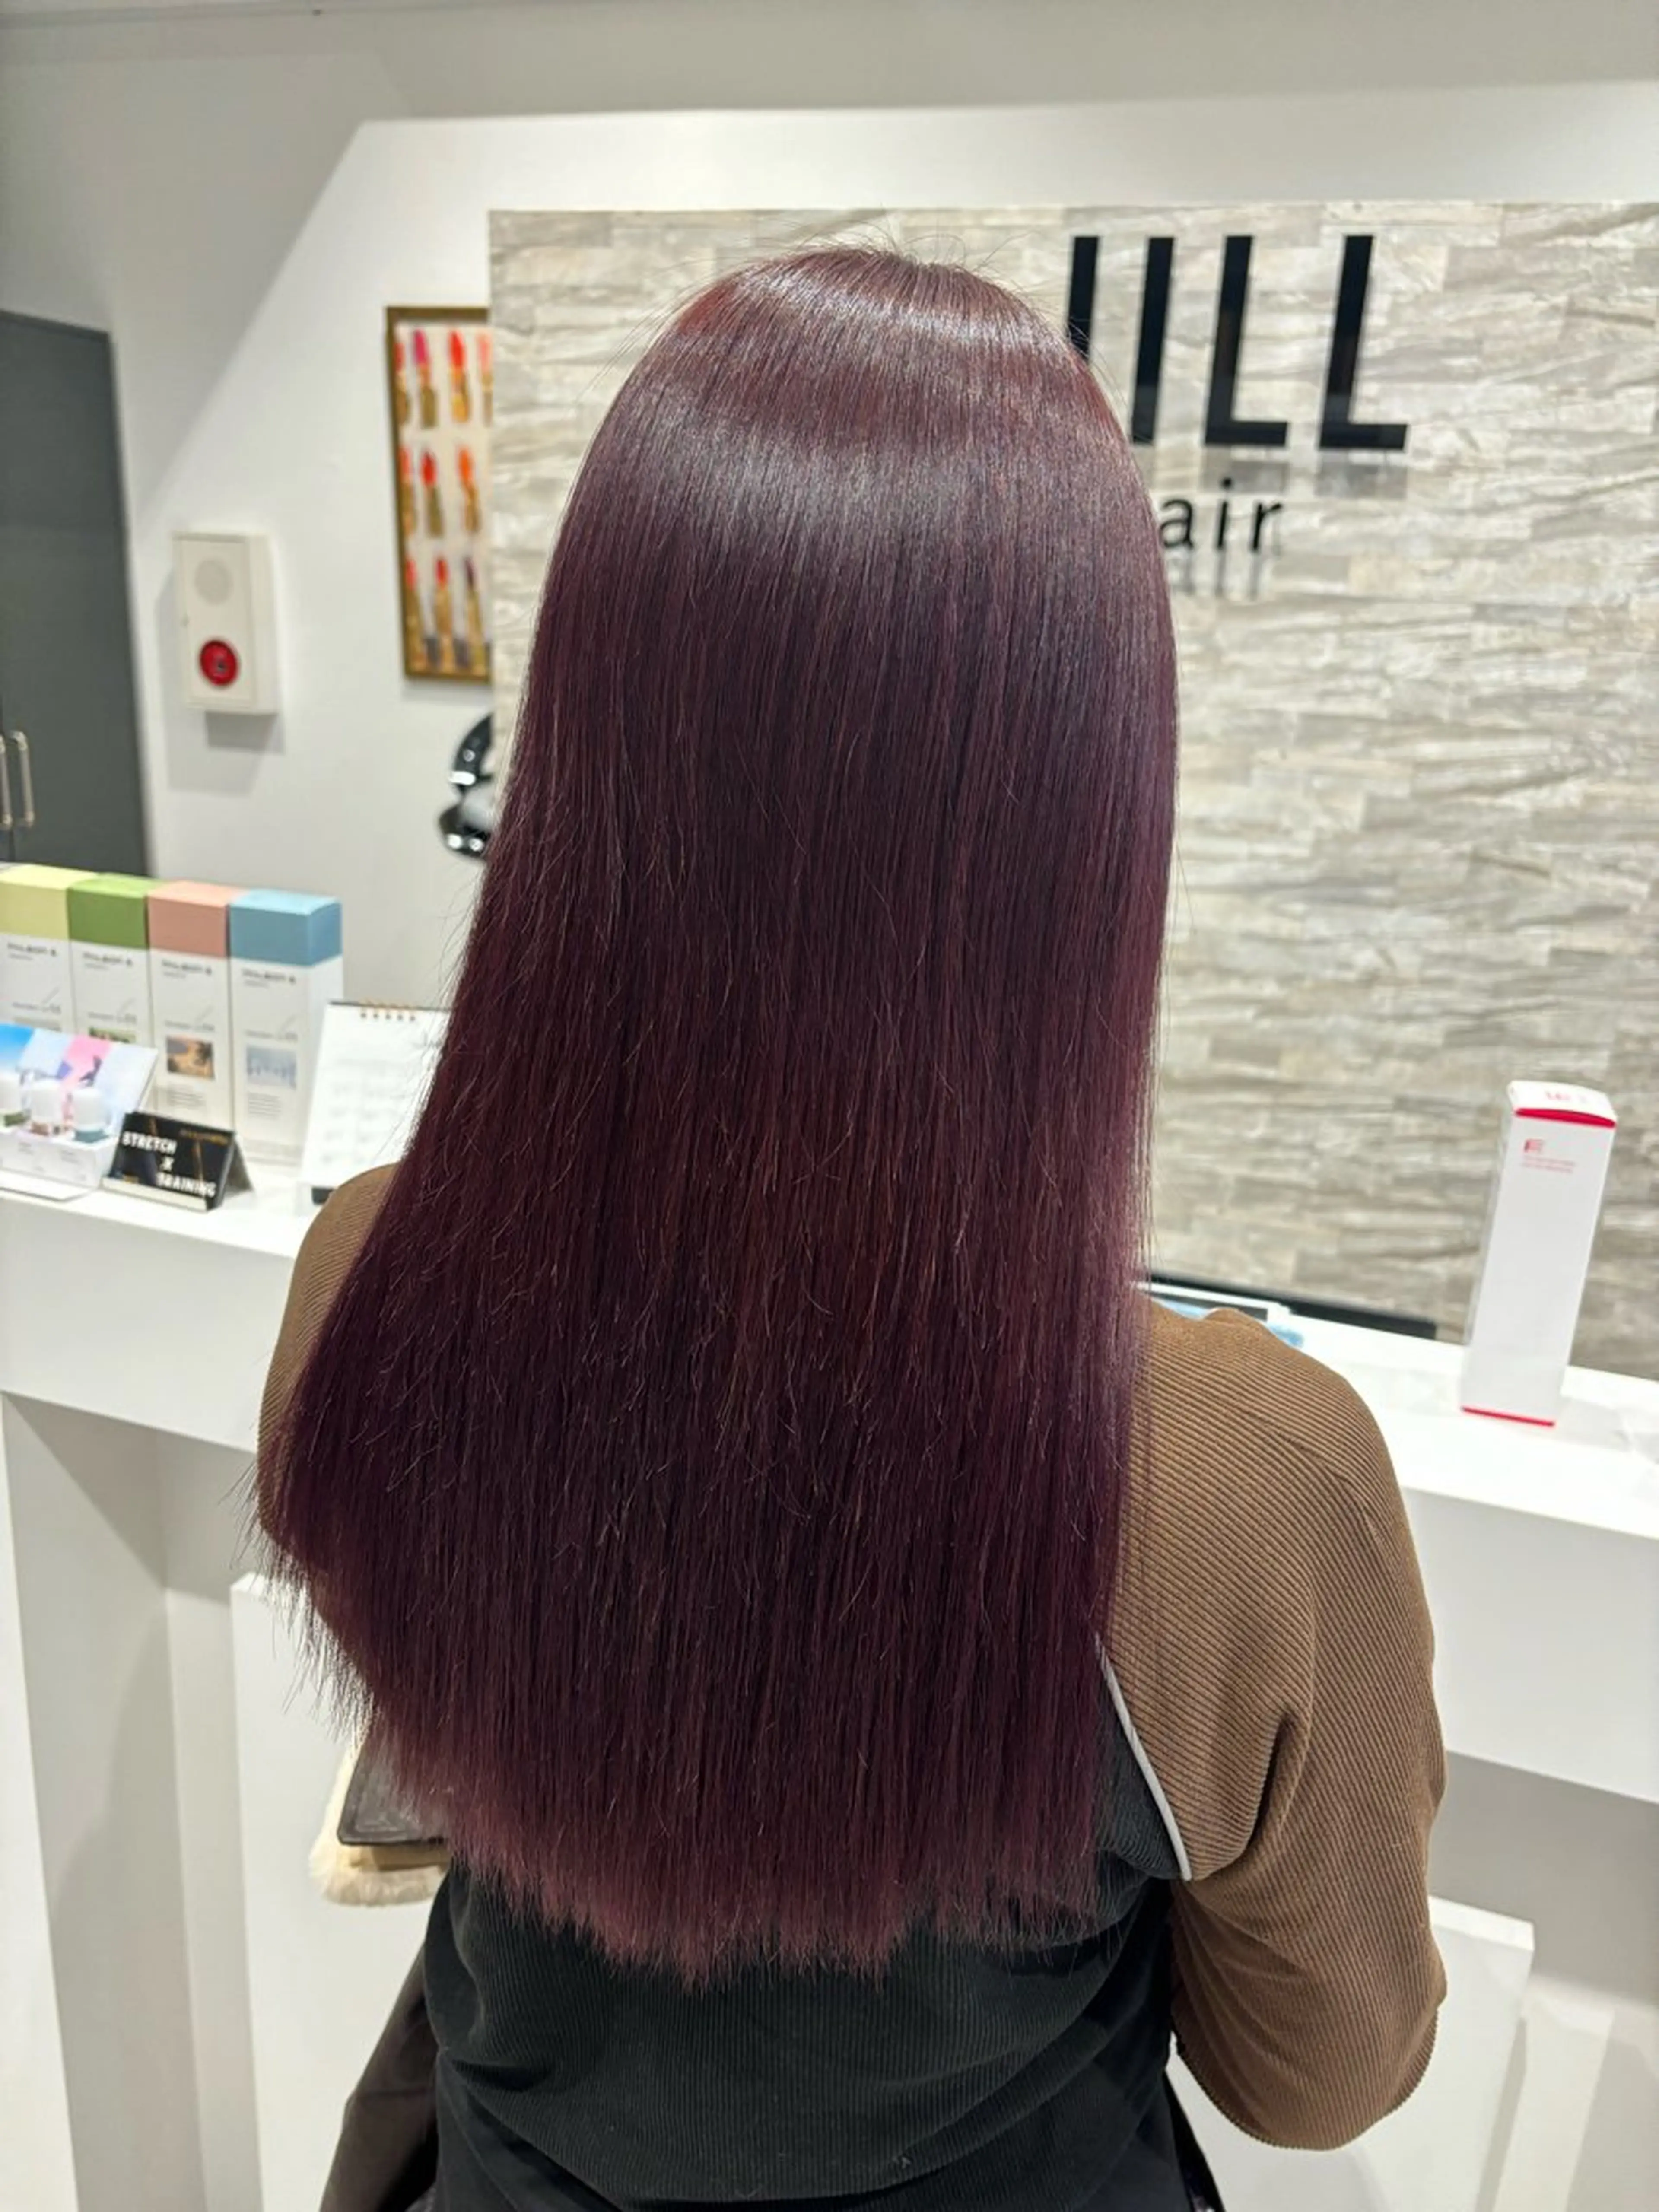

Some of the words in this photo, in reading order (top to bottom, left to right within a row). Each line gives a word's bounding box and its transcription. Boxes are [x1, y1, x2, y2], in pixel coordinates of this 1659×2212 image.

[1159, 477, 1283, 551] air
[123, 1131, 178, 1154] STRETCH
[156, 1172, 216, 1197] TRAINING
